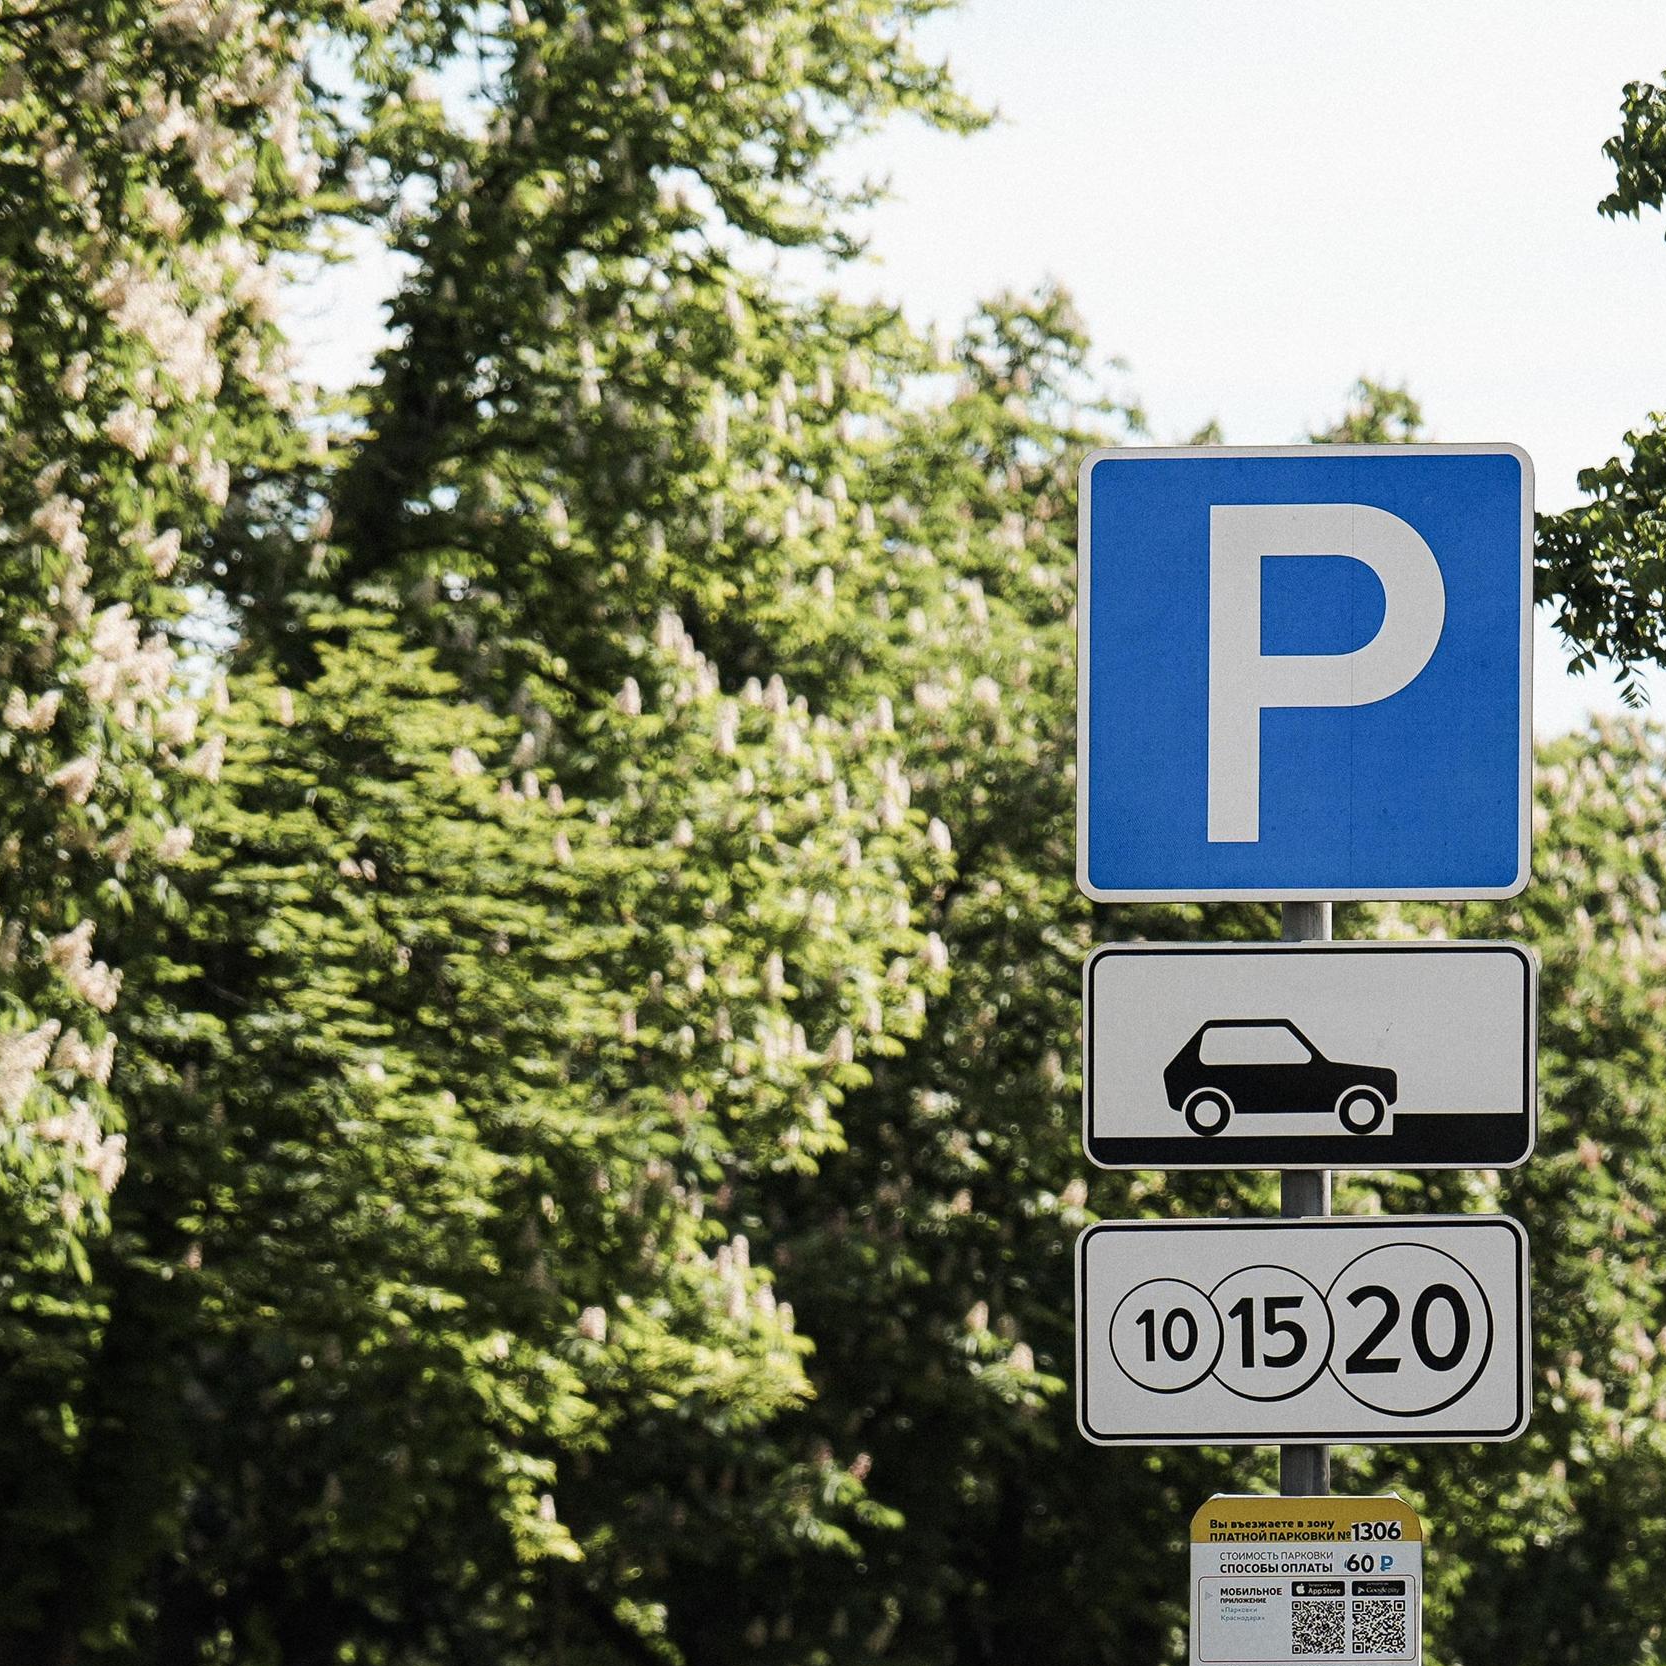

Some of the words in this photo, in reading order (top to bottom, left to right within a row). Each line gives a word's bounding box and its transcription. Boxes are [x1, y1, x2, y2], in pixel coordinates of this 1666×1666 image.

[1208, 503, 1446, 842] P
[1135, 1307, 1198, 1362] 10
[1227, 1296, 1308, 1369] 15
[1346, 1283, 1470, 1375] 20
[1210, 1519, 1227, 1529] Вы
[1231, 1520, 1294, 1529] въезжаете
[1307, 1520, 1334, 1530] зону
[1210, 1531, 1266, 1541] ПЛАТНОЙ
[1269, 1532, 1334, 1541] ПАРКОВКИ
[1351, 1522, 1401, 1541] 1306
[1220, 1552, 1278, 1561] СТОИМОСТЬ
[1281, 1551, 1333, 1560] ПАРКОВКИ
[1346, 1553, 1374, 1573] 60
[1220, 1564, 1278, 1573] СПОСОБЫ
[1281, 1563, 1333, 1573] ОПЛАТЫ
[1220, 1587, 1282, 1596] МОБИЛЬНОЕ
[1323, 1587, 1341, 1595] Store
